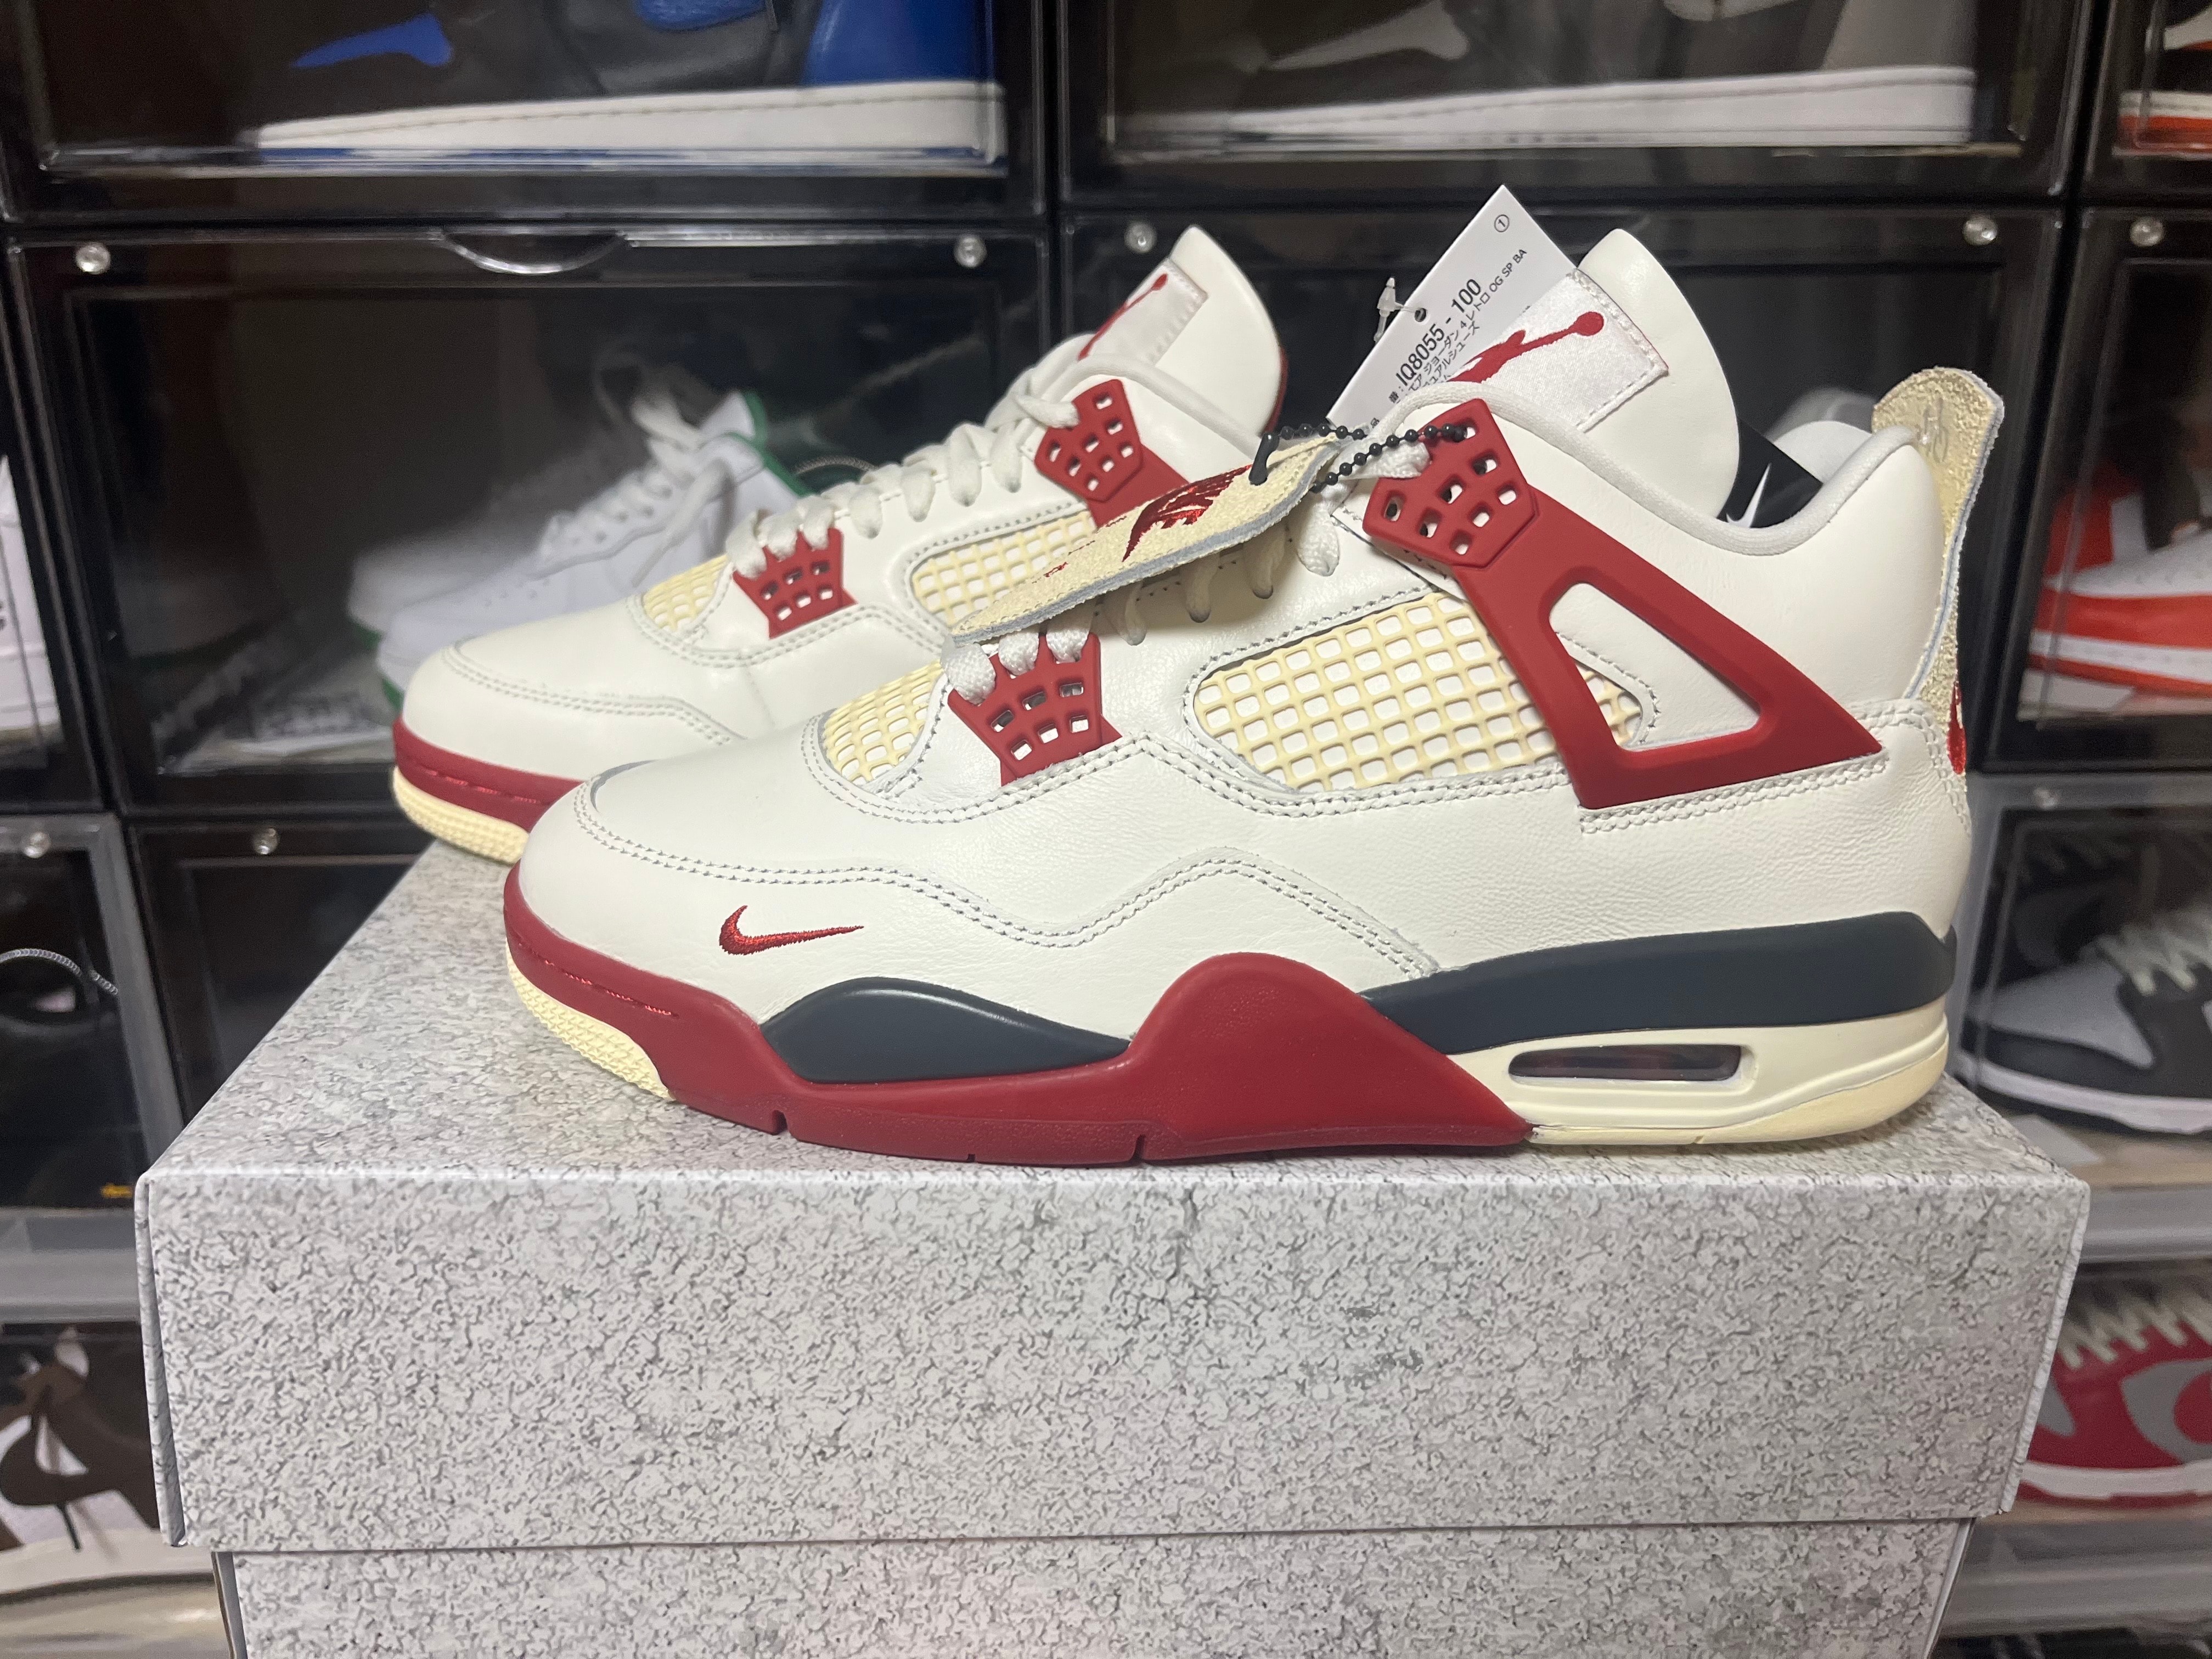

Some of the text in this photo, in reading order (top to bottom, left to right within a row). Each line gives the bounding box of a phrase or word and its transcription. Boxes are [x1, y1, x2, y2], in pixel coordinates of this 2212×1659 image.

[1489, 275, 1504, 292] OG
[1501, 262, 1513, 278] SP
[1512, 249, 1528, 264] BA
[1395, 323, 1444, 386] IQ8055
[1451, 279, 1481, 313] 100
